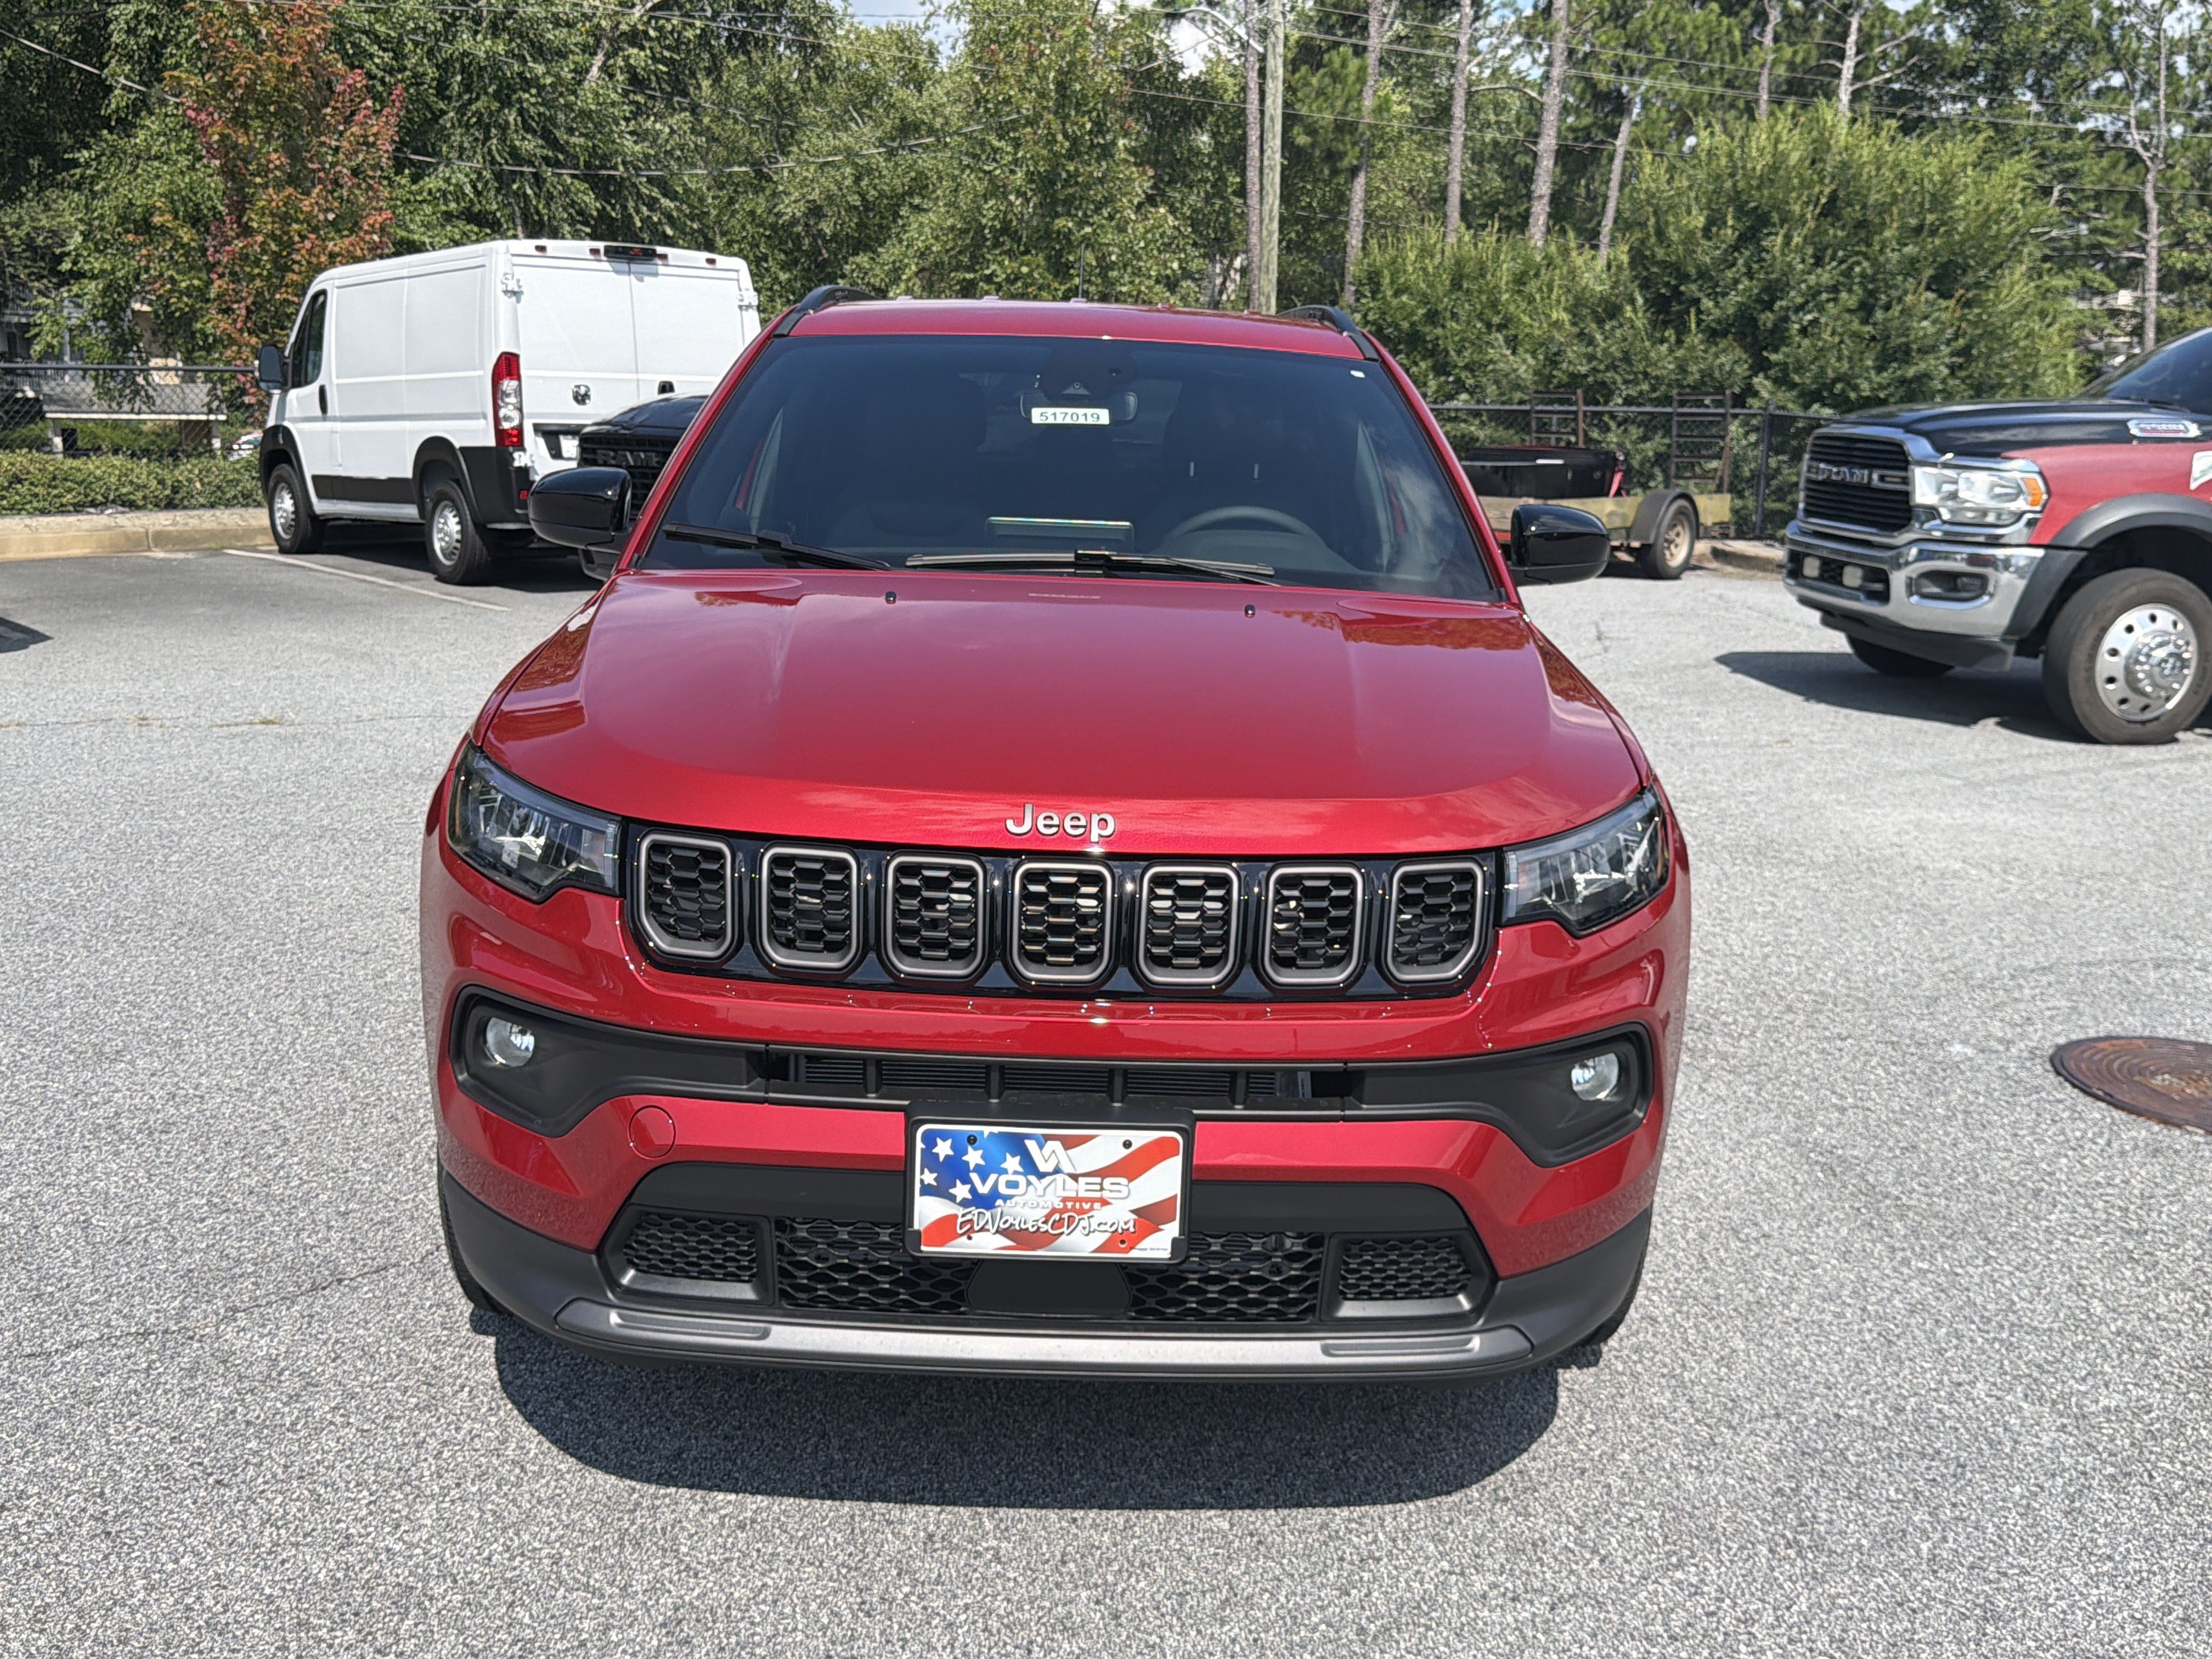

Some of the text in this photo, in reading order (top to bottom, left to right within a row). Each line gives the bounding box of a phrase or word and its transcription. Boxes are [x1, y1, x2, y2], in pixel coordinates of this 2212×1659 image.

[1039, 411, 1101, 422] 517019
[597, 450, 658, 466] RAM
[1819, 463, 1870, 483] RAM
[1005, 803, 1116, 843] Jeep
[969, 1172, 1130, 1199] VOYLES
[994, 1199, 1102, 1210] AUTOMOTIVE
